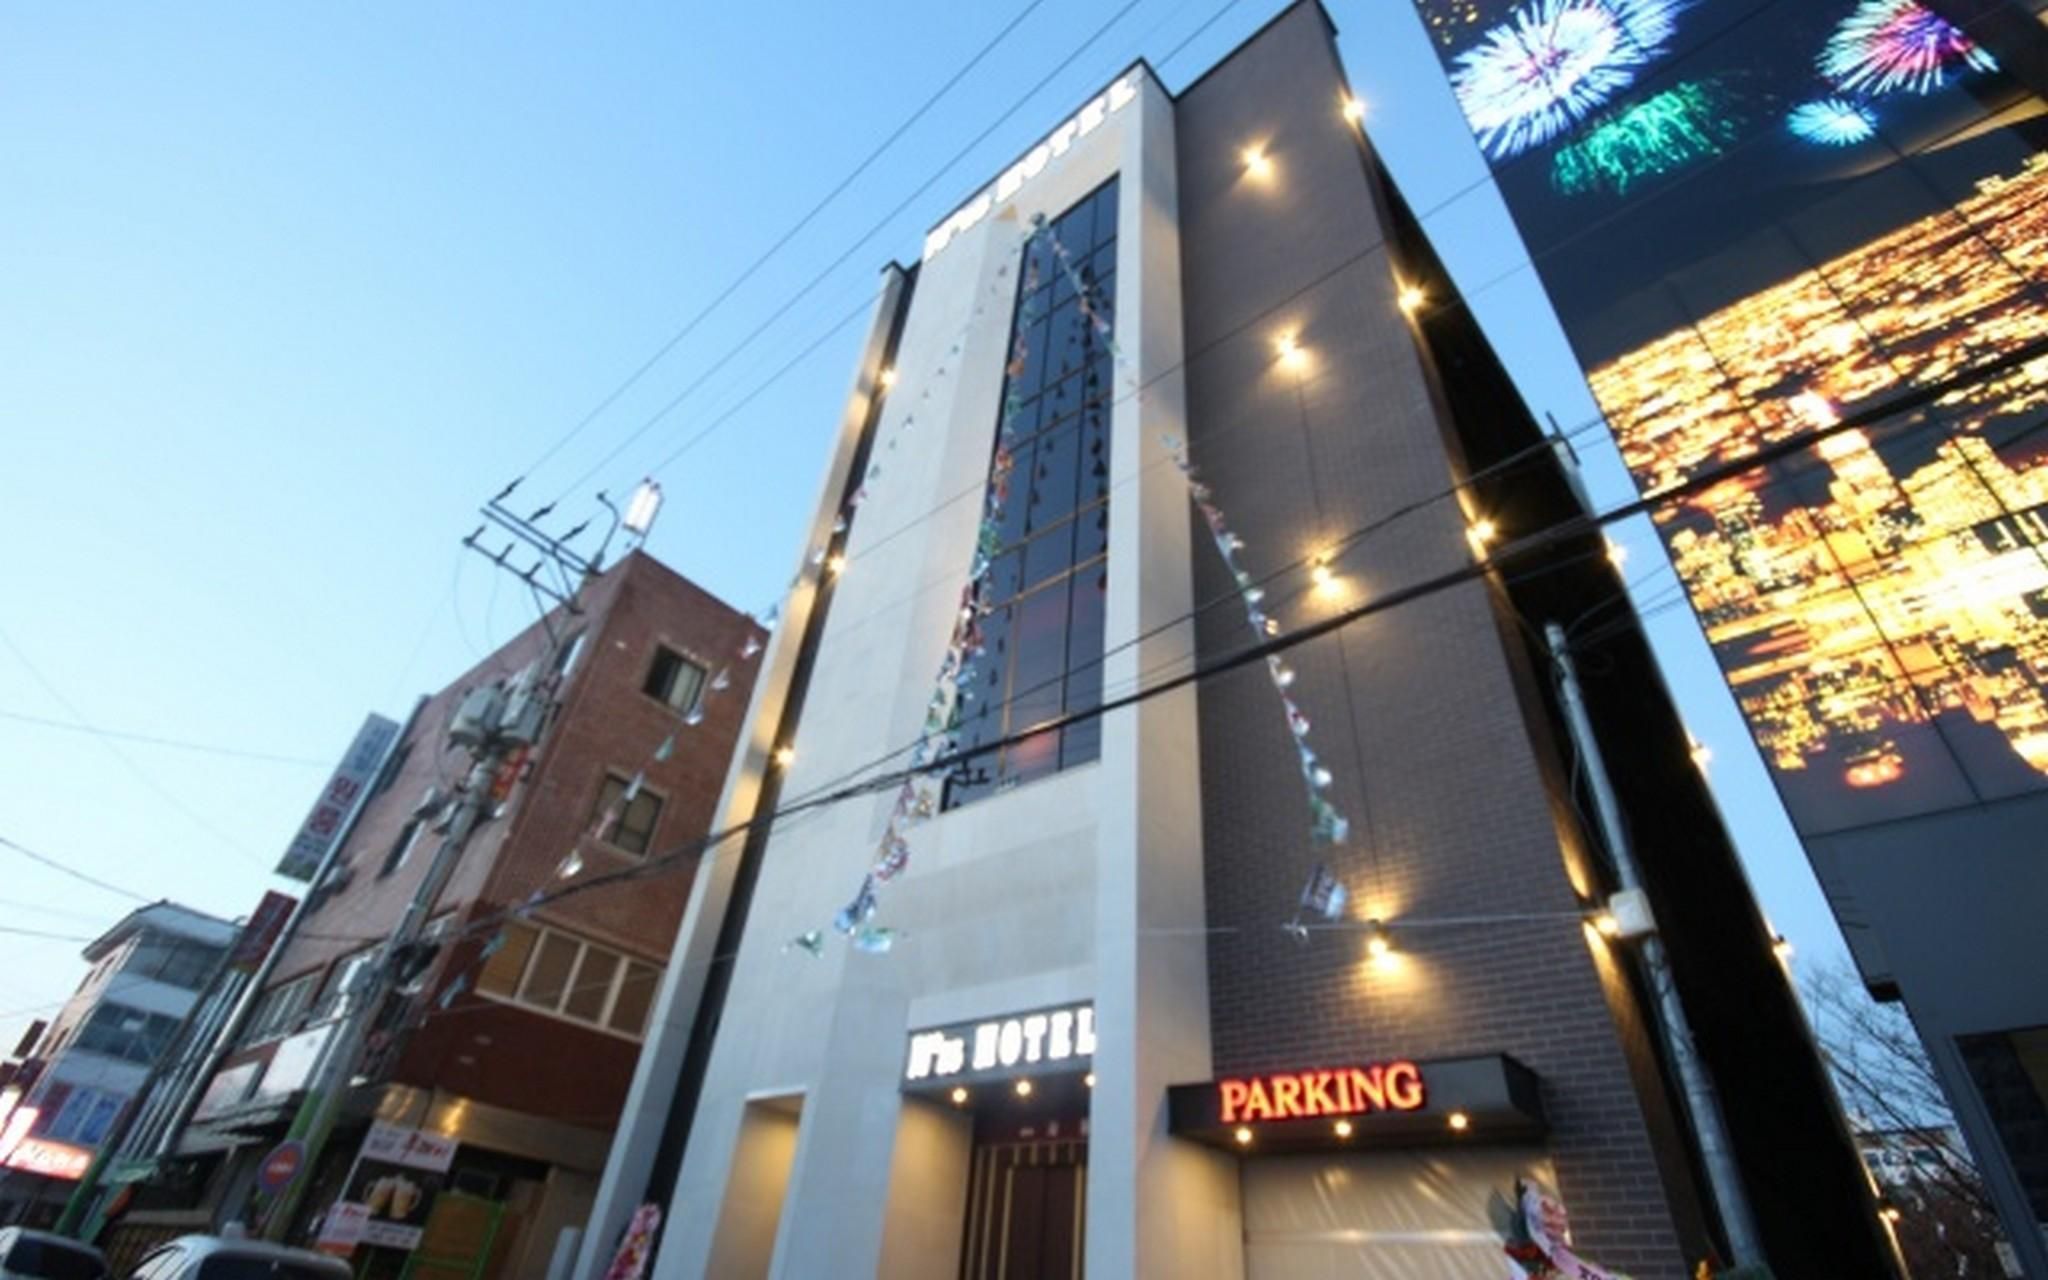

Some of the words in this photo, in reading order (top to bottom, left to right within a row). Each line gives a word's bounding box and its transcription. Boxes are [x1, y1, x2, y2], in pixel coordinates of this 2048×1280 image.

[996, 79, 1136, 202] HOTEL
[972, 1007, 1096, 1070] HOTEL
[1219, 1061, 1423, 1123] PARKING
